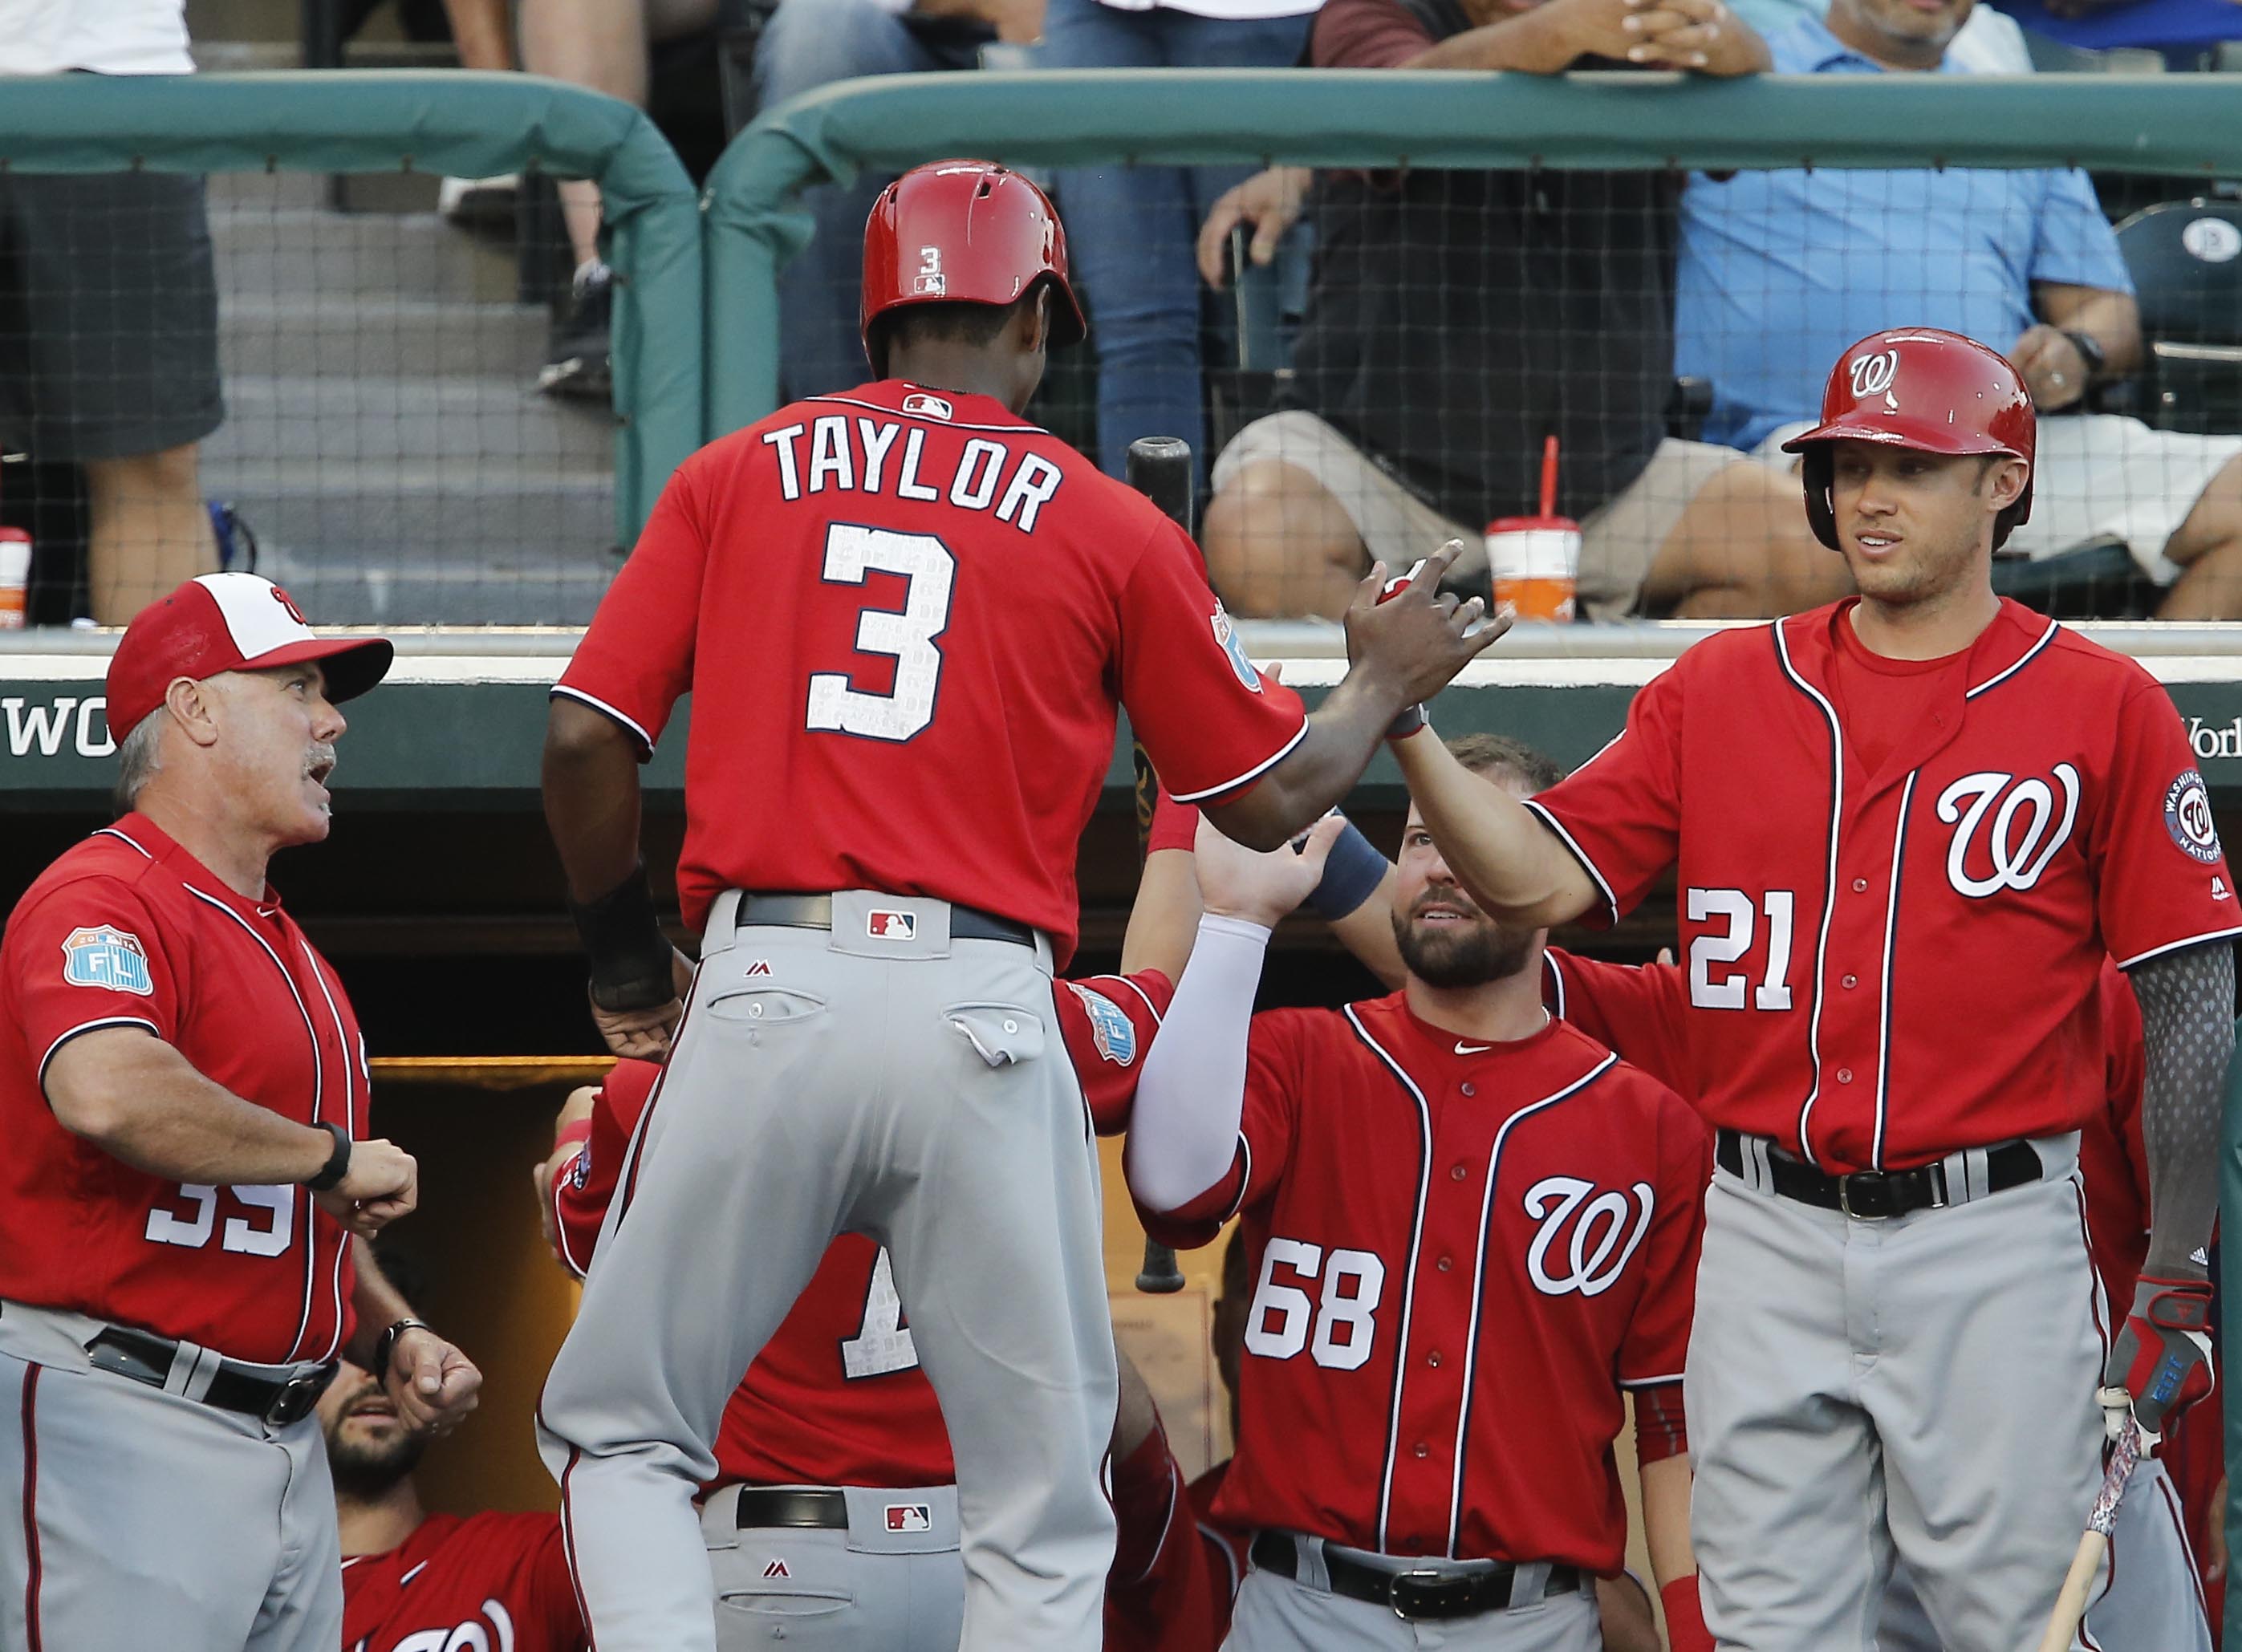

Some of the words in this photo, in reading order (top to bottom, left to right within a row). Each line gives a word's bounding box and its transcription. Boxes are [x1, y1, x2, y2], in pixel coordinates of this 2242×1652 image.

[920, 246, 940, 274] 3
[1849, 348, 1899, 398] W
[762, 414, 1064, 535] TAYLOR
[806, 522, 957, 743] 3
[1935, 761, 2081, 899] W
[88, 952, 133, 979] FL
[1687, 887, 1794, 1011] 21
[1523, 1175, 1655, 1297] W
[1244, 1236, 1387, 1372] 68
